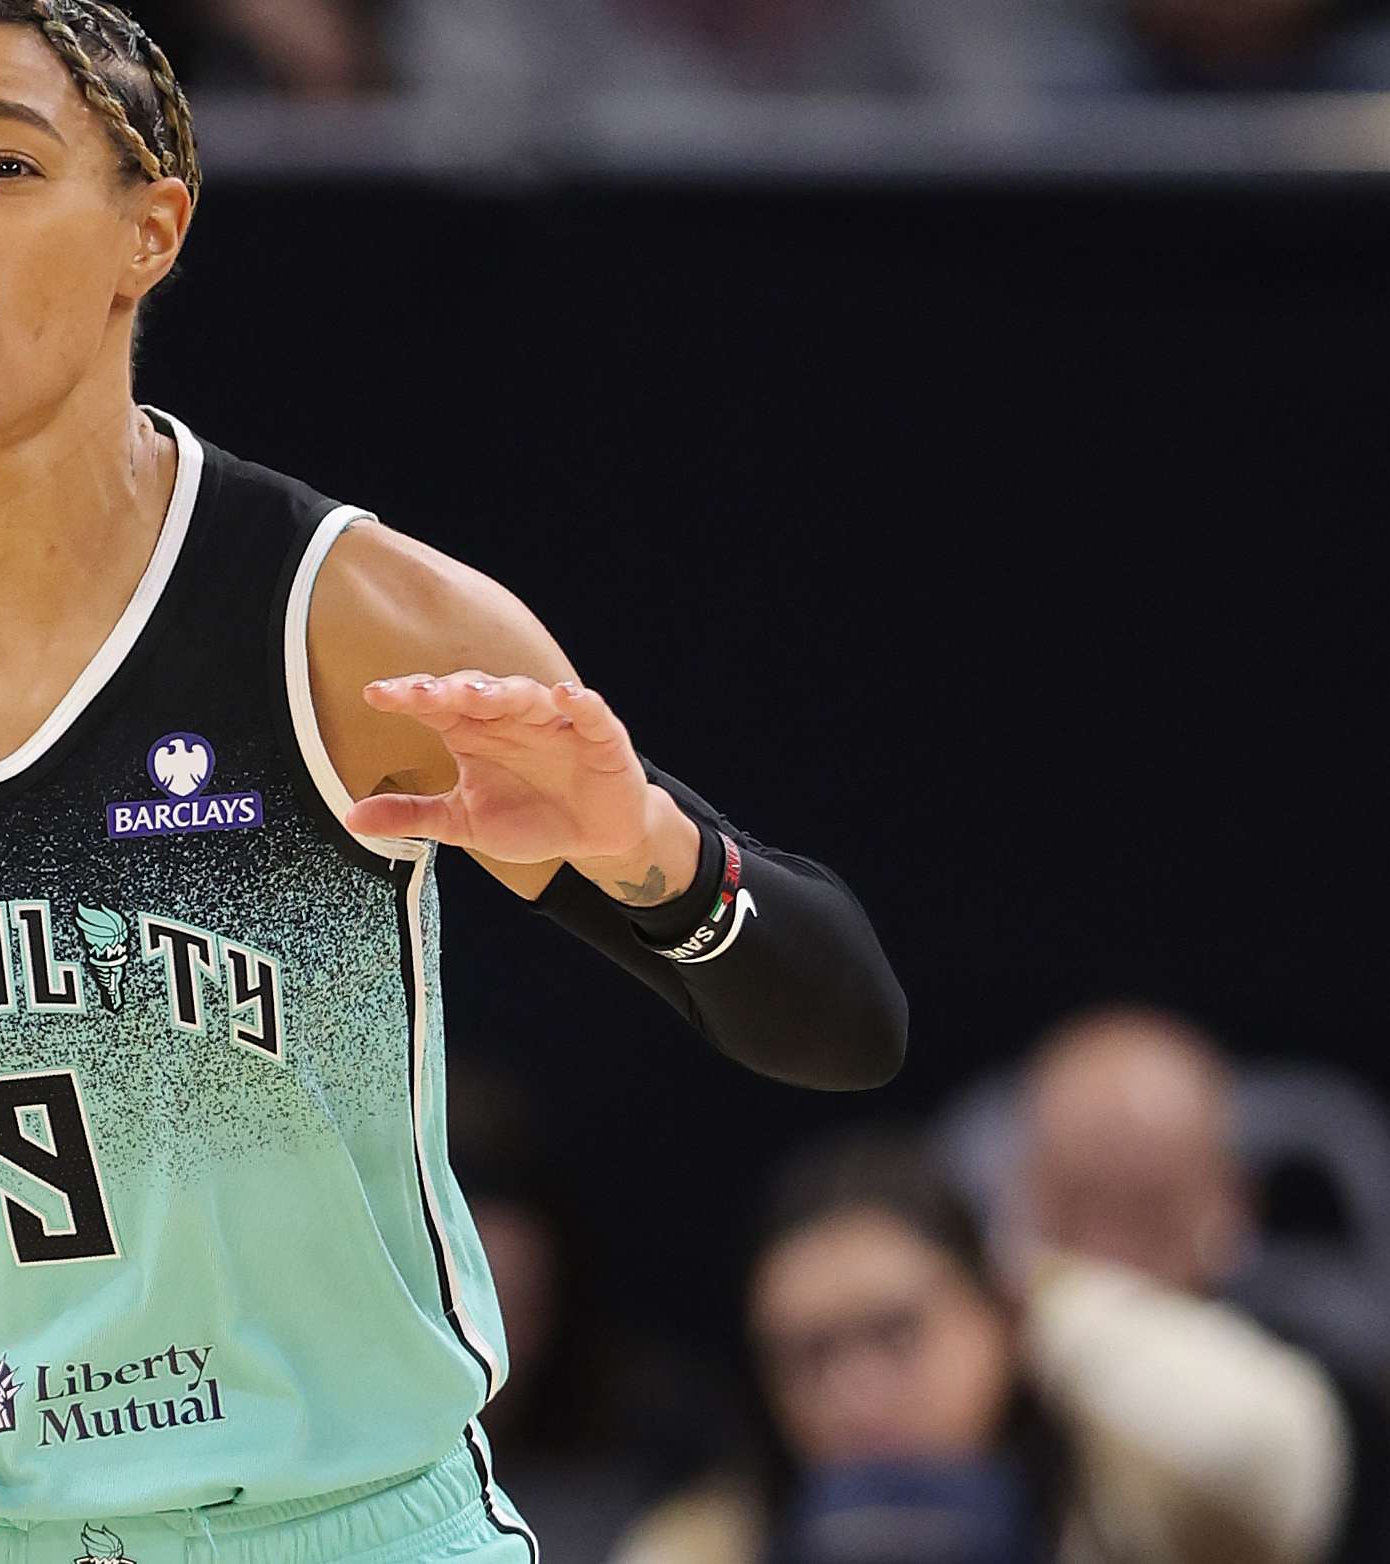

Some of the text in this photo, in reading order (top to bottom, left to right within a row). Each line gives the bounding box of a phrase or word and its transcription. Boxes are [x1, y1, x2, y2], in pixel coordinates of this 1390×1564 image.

[114, 797, 256, 833] BARCLAYS
[35, 1343, 214, 1402] Liberty
[37, 1378, 226, 1448] Mutual
